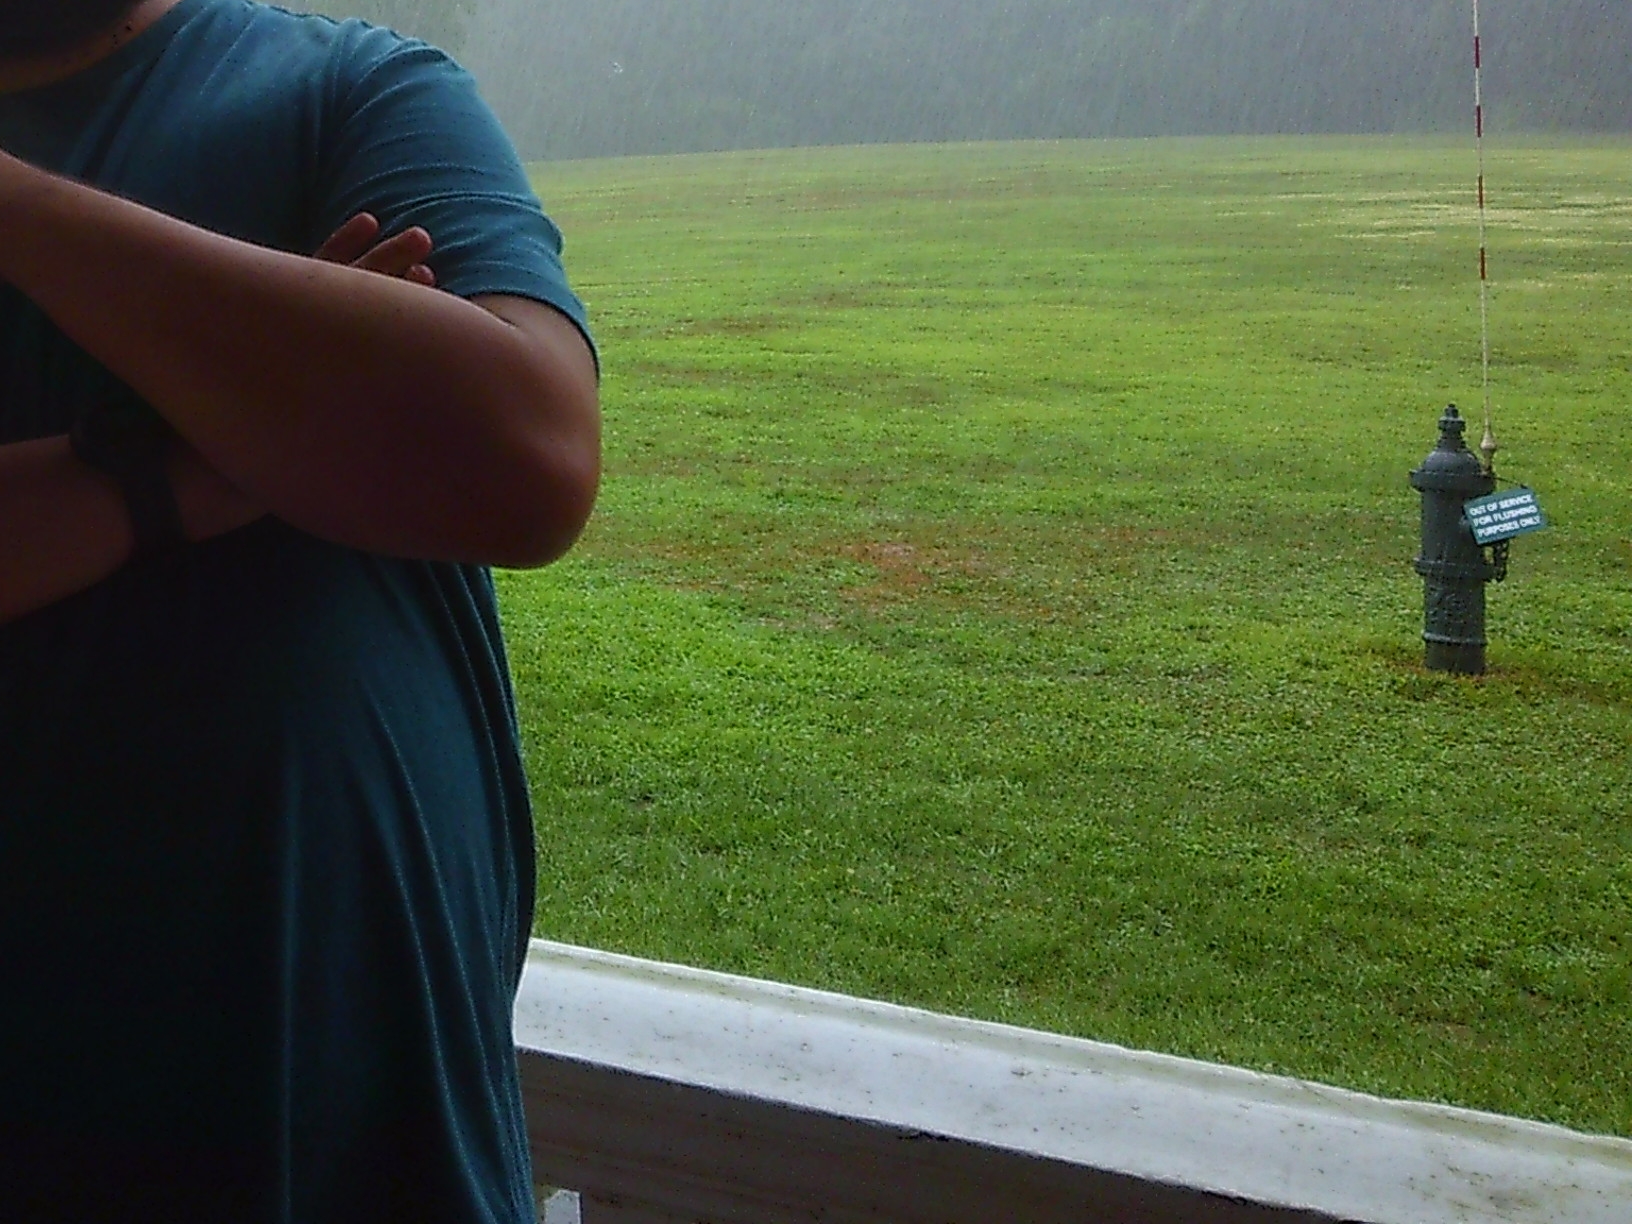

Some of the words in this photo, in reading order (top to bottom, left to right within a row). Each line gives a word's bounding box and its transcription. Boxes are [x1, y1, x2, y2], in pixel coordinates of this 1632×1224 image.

[1470, 505, 1486, 515] OUT
[1487, 503, 1498, 512] OF
[1499, 494, 1533, 508] SERVICE
[1473, 515, 1493, 526] FOR
[1493, 505, 1537, 521] FLUSHING
[1477, 521, 1519, 537] PURPOSES
[1520, 515, 1541, 527] ONLY
